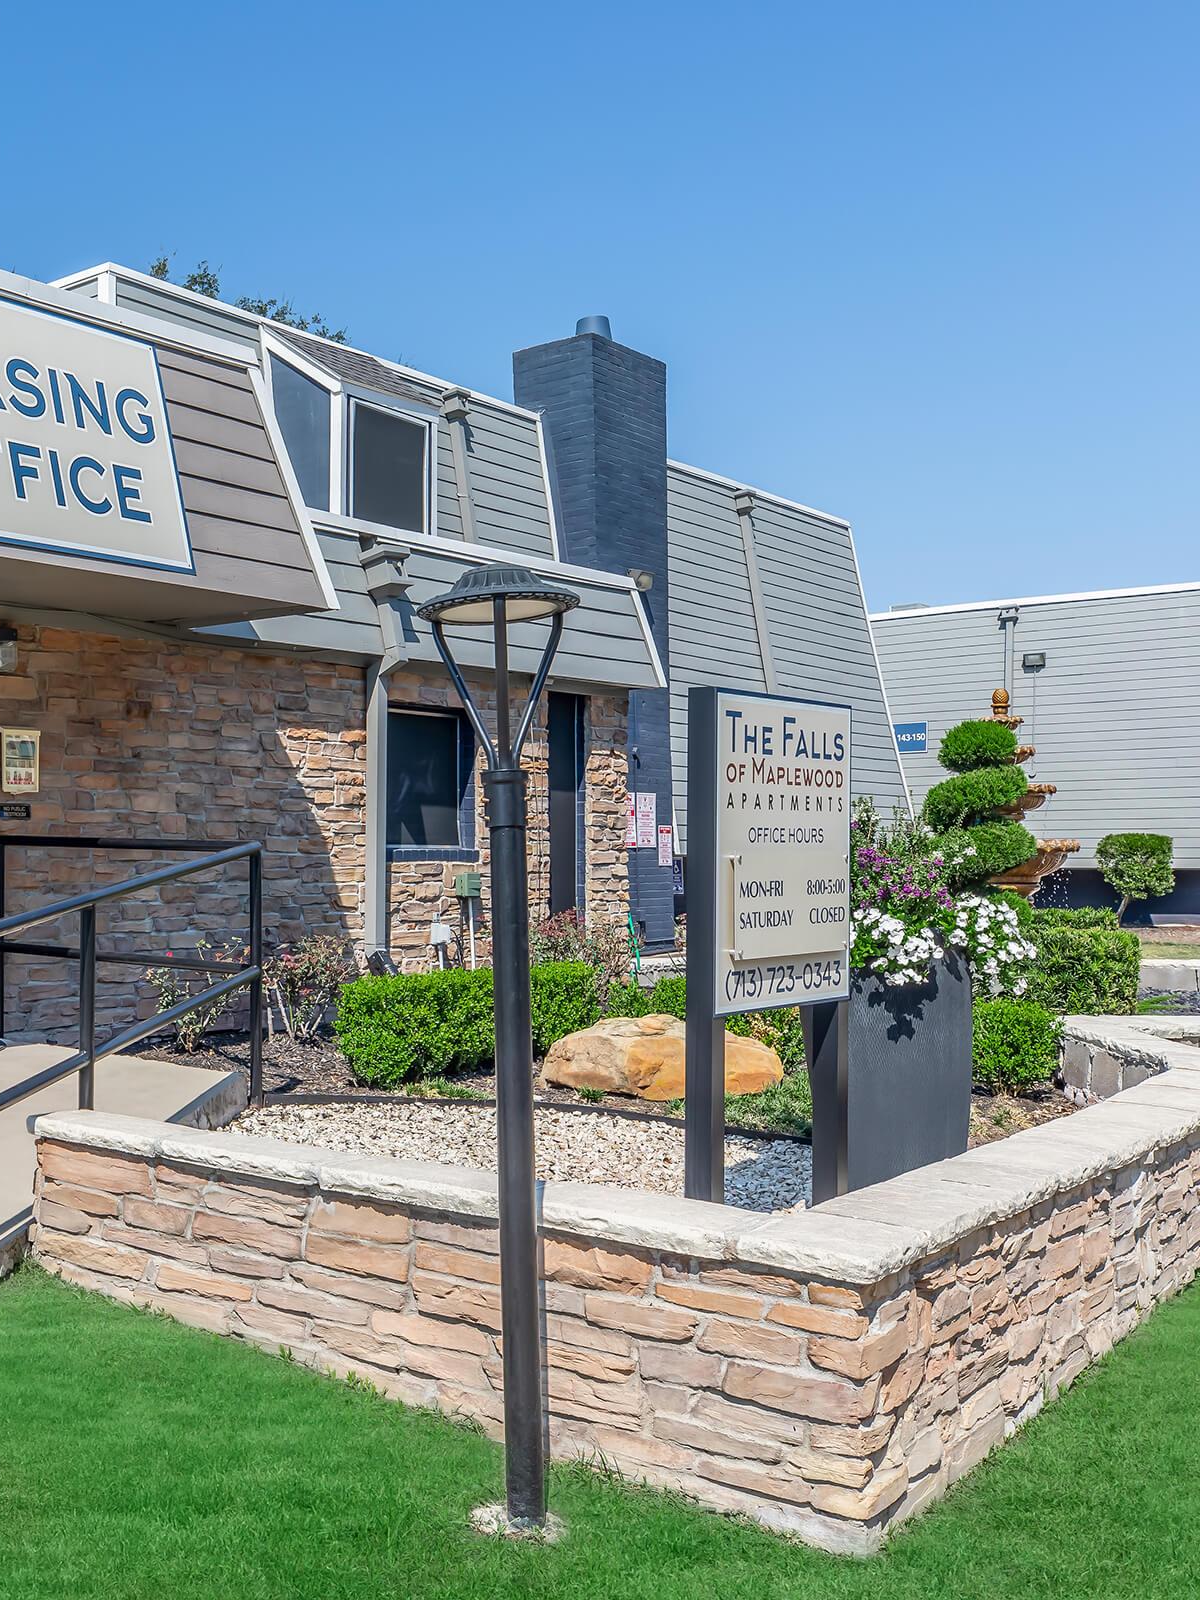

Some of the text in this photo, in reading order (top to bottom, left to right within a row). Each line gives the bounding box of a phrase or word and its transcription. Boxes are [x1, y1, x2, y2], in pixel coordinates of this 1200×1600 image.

[896, 732, 926, 742] 143-150
[726, 756, 844, 789] OF MAPLEWOOD
[726, 791, 843, 813] APARTMENTS
[748, 826, 825, 844] OFFICE HOURS
[739, 878, 846, 899] MON-FRI 8:00-5:00
[739, 906, 846, 930] SATURDAY CLOSED
[725, 960, 841, 1002] (713) 723-0343
